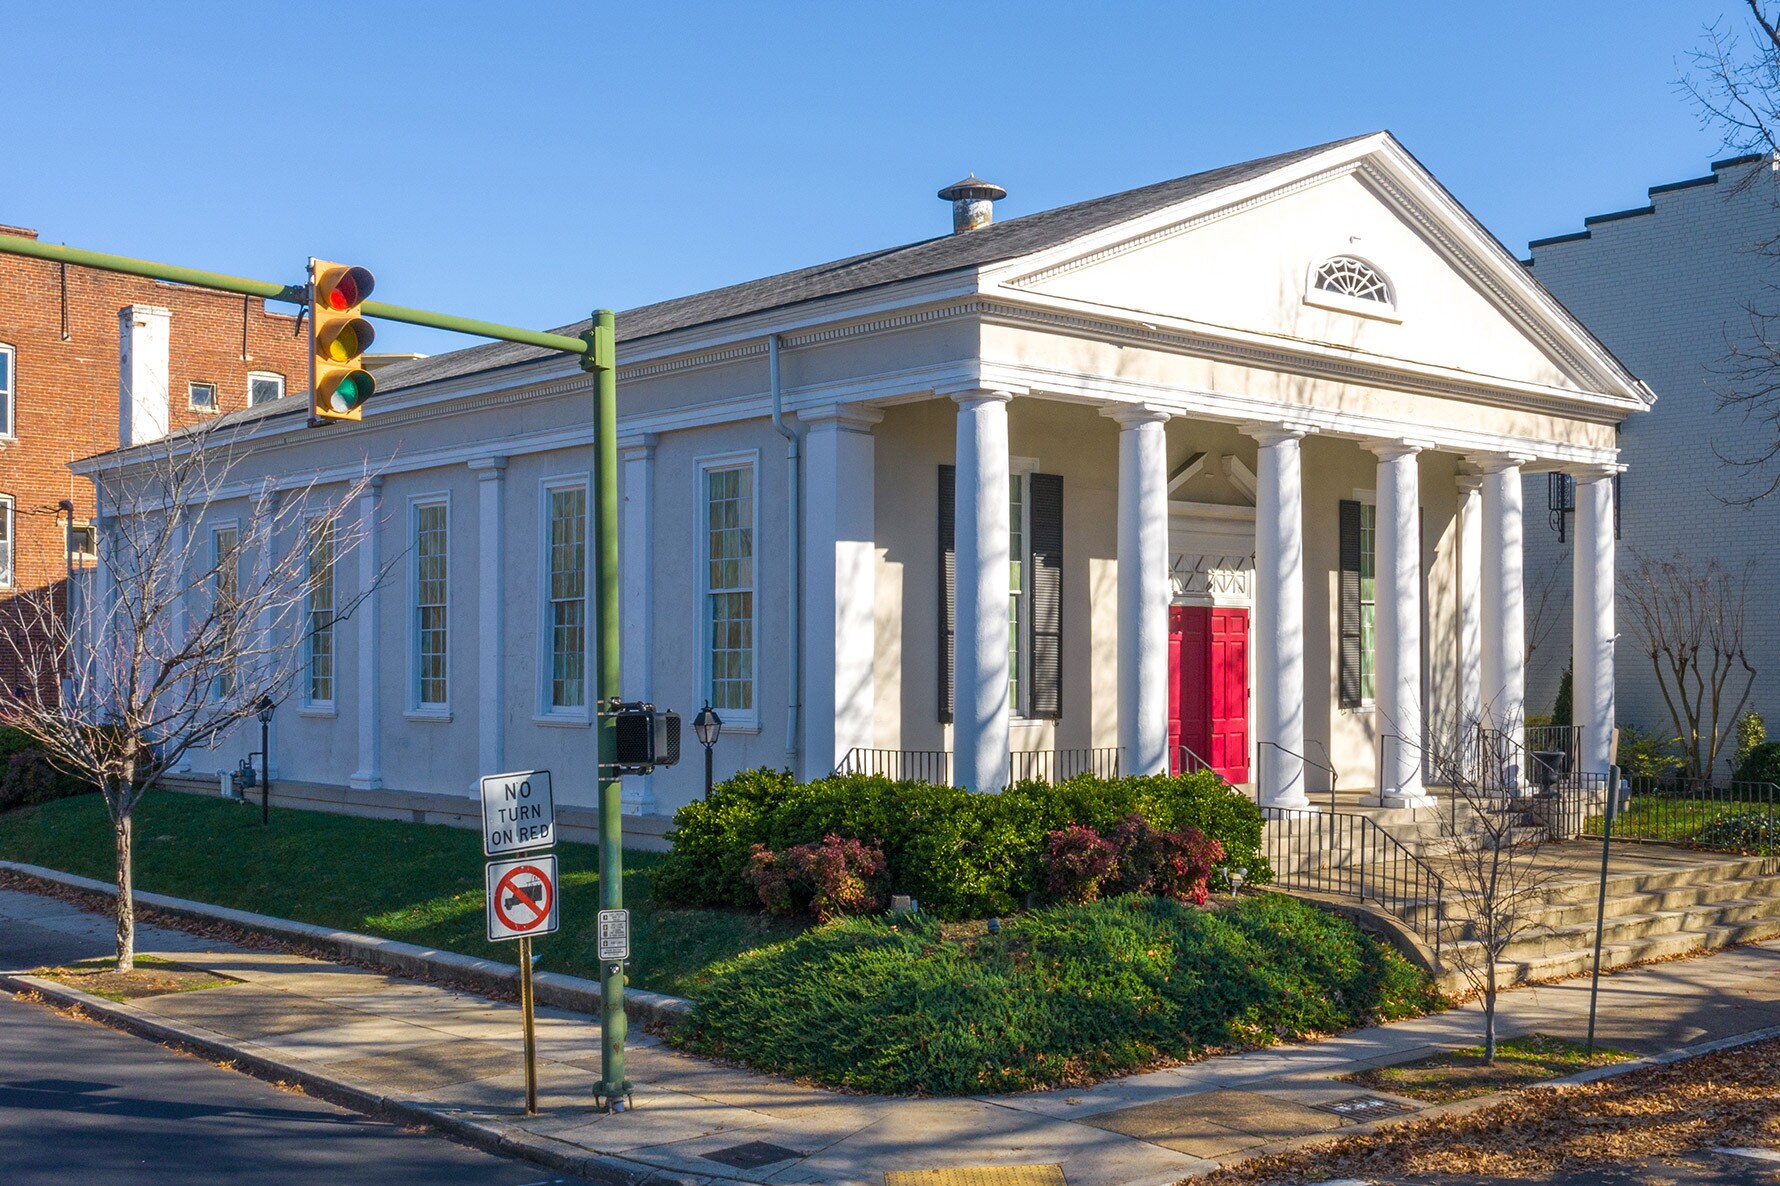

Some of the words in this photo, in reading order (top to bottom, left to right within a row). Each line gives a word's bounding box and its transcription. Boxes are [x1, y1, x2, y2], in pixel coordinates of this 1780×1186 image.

[505, 781, 531, 800] NO
[498, 804, 541, 823] TURN
[492, 829, 513, 846] ON
[519, 824, 549, 843] RED
